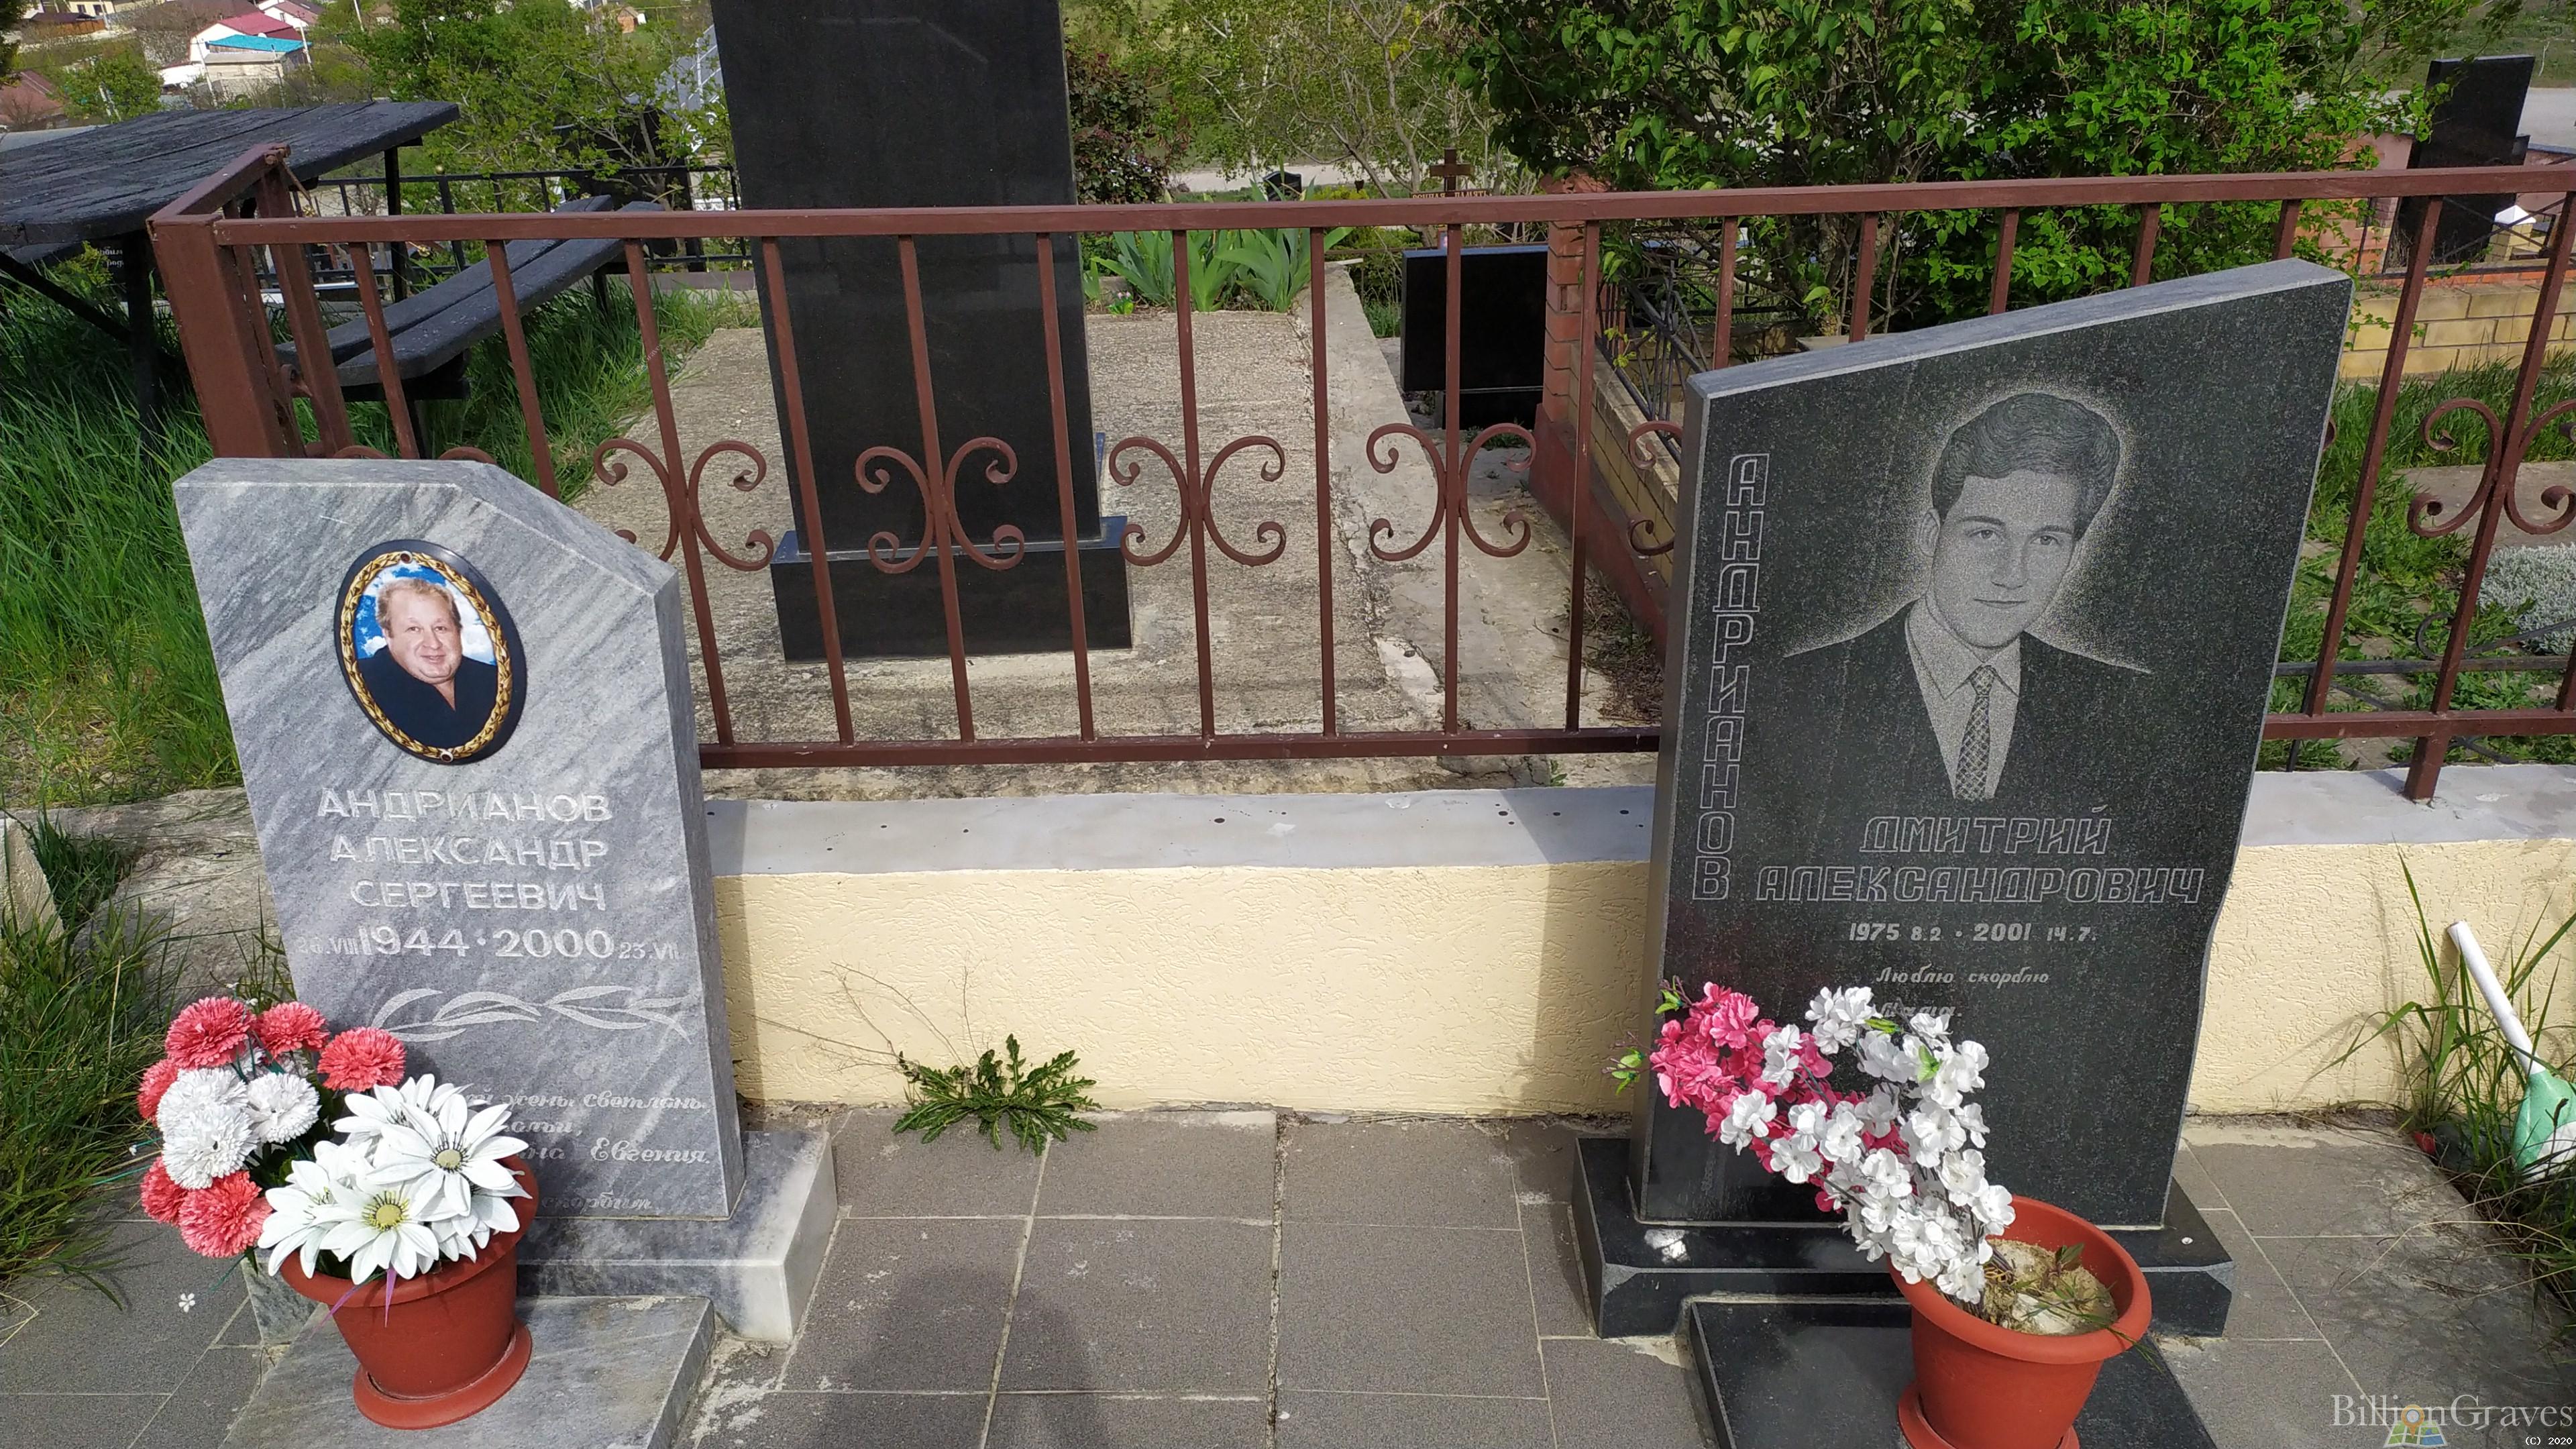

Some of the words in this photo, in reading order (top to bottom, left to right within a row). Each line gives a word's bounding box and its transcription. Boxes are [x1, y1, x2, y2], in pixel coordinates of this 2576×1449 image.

[1693, 453, 1770, 901] АНДРИАНОВ
[317, 787, 613, 822] АНДРИАНОВ
[1860, 806, 2112, 855] ДМИТРИЙ
[330, 834, 608, 870] АЛЕКСАНДР
[350, 878, 606, 911] СЕРГЕЕВИЧ
[1756, 865, 2204, 904] АЛЕКСАНДРОВИЧ
[358, 925, 470, 957] 1944
[492, 928, 615, 959] 2000
[1848, 922, 1900, 941] 1975
[1973, 922, 2032, 941] 2001
[1876, 962, 1954, 983] Люблю
[1968, 965, 2050, 989] скорблю
